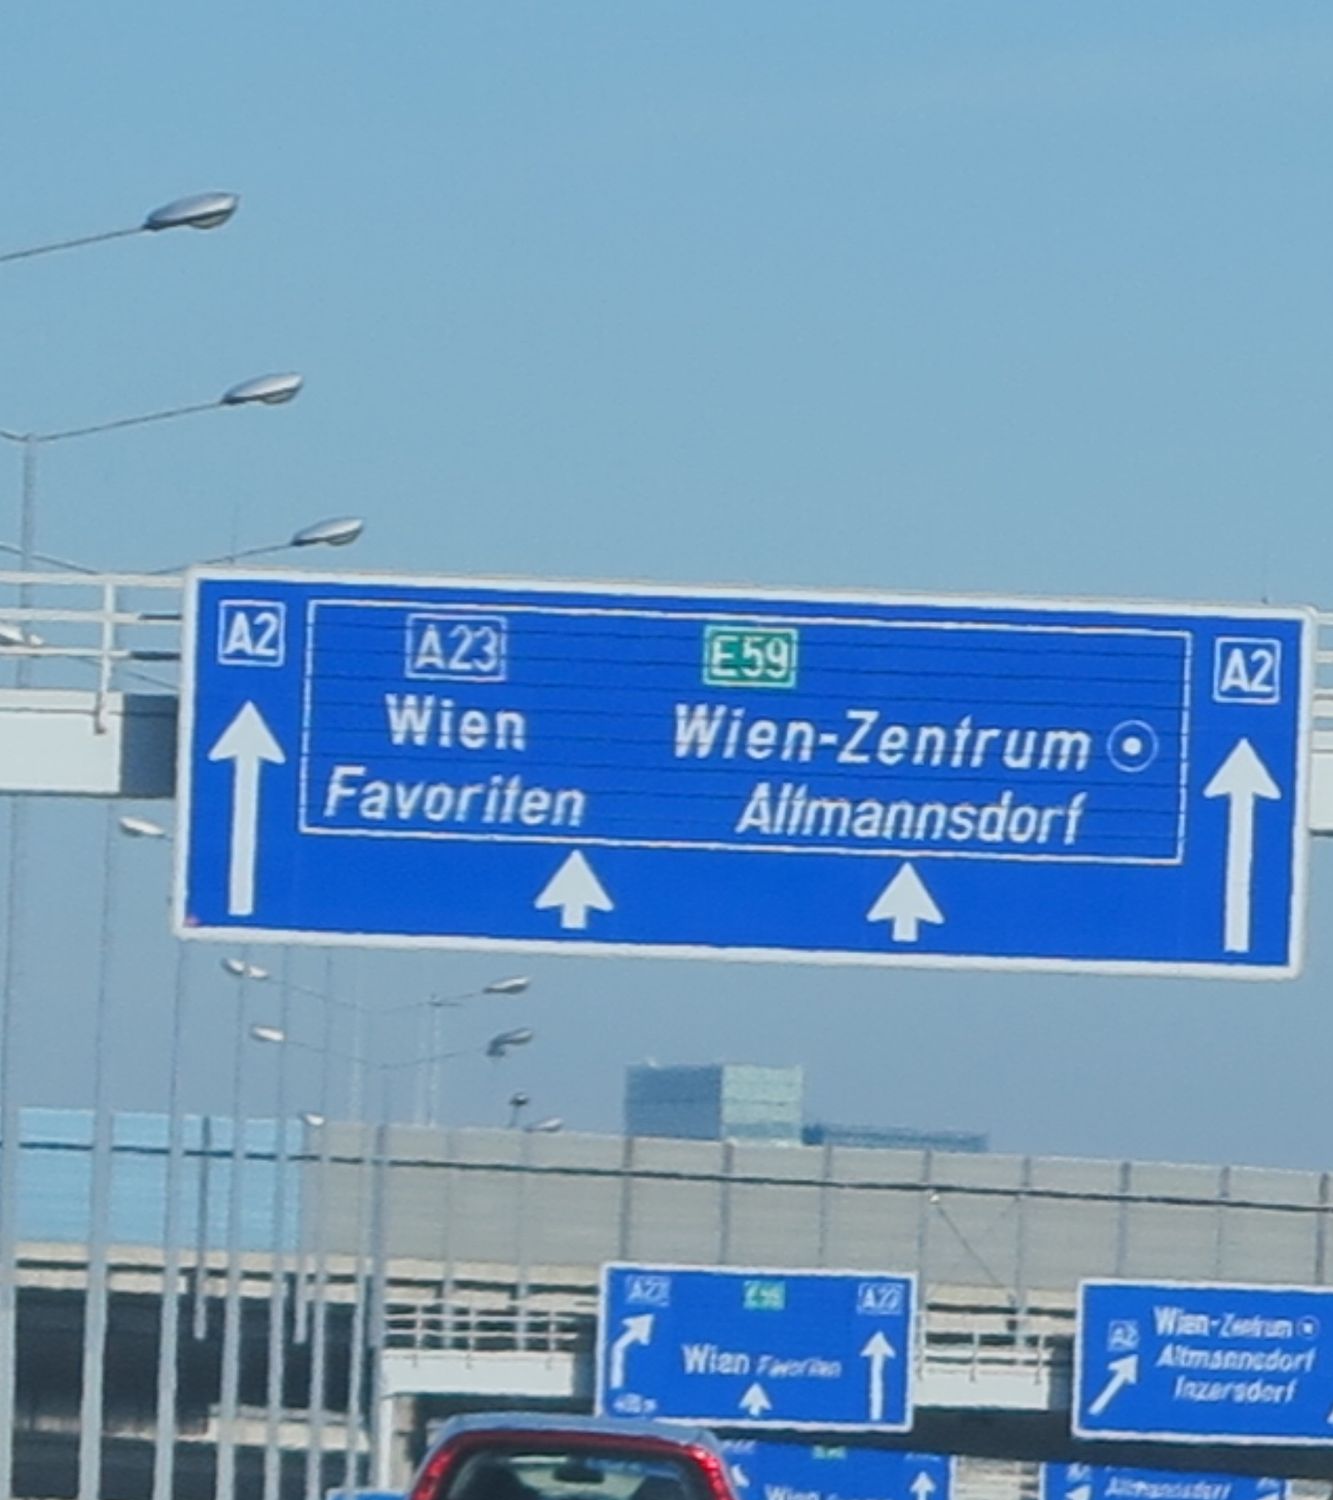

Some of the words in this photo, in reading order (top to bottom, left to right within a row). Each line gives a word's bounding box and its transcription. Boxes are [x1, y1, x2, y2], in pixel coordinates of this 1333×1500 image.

[224, 610, 281, 657] A2
[414, 627, 499, 672] A23
[710, 635, 789, 680] E59
[1220, 647, 1274, 694] A2
[384, 693, 527, 751] Wien
[673, 703, 1091, 772] Wien-Zentrum
[324, 765, 587, 827] Favoriten
[735, 783, 1088, 846] Altmannsdorf
[682, 1343, 750, 1375] Wien
[1156, 1343, 1316, 1373] Altmannsdorf
[1173, 1374, 1297, 1404] Inzersdorf
